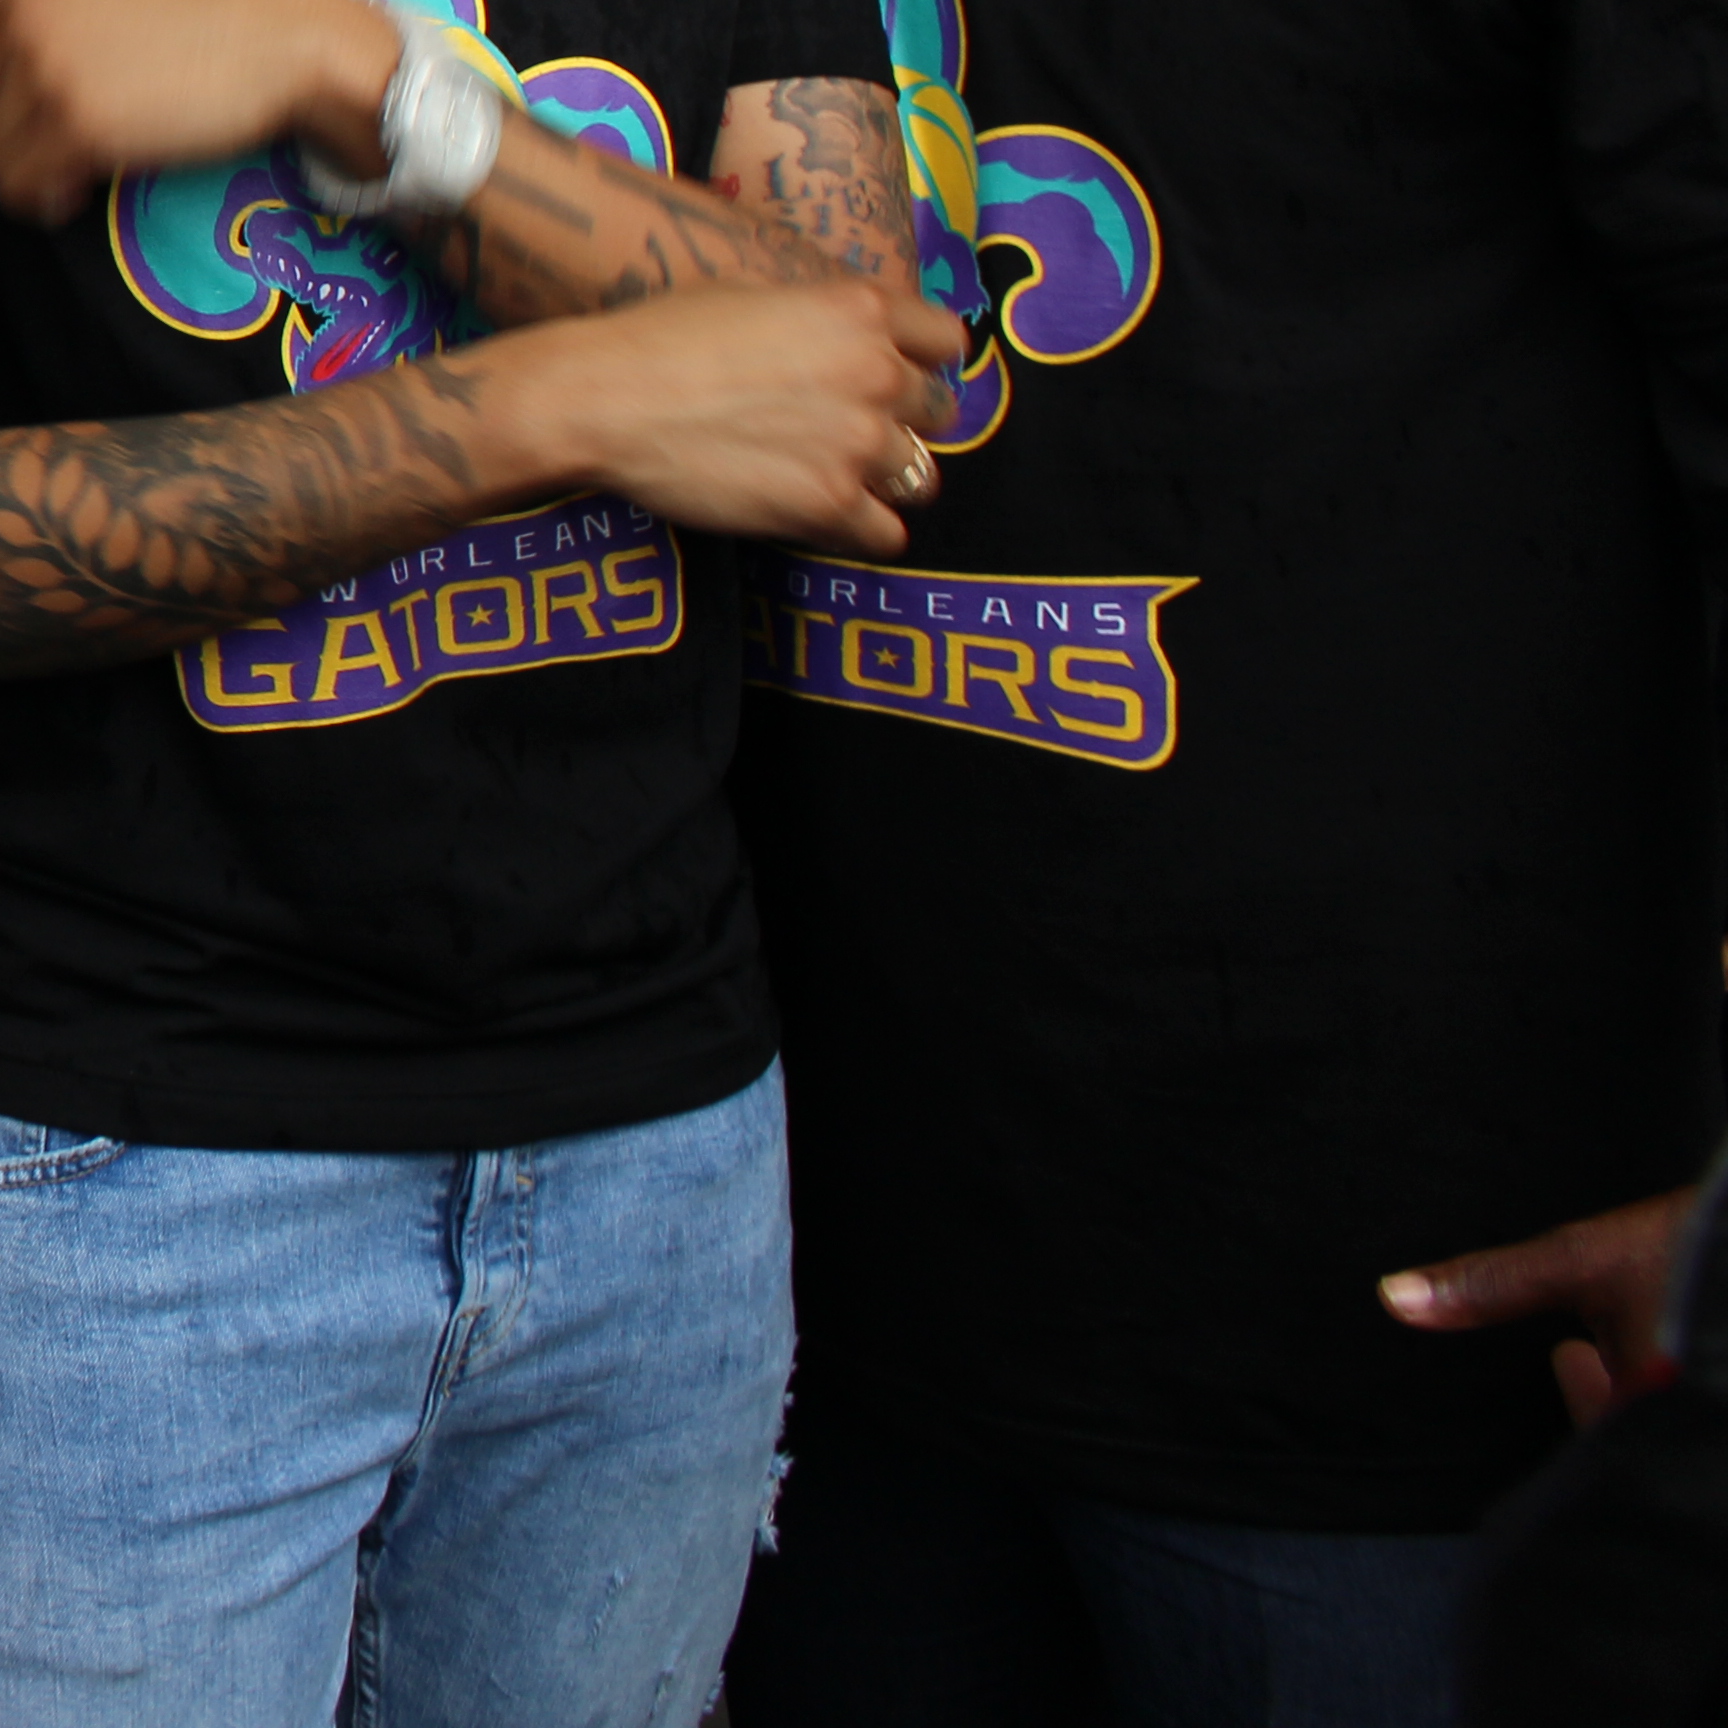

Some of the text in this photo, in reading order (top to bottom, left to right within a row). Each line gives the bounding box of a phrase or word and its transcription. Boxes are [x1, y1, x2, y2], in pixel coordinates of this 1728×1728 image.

[390, 502, 654, 586] ORLEANS
[200, 544, 665, 707] GATORS
[787, 573, 1126, 635] ORLEANS
